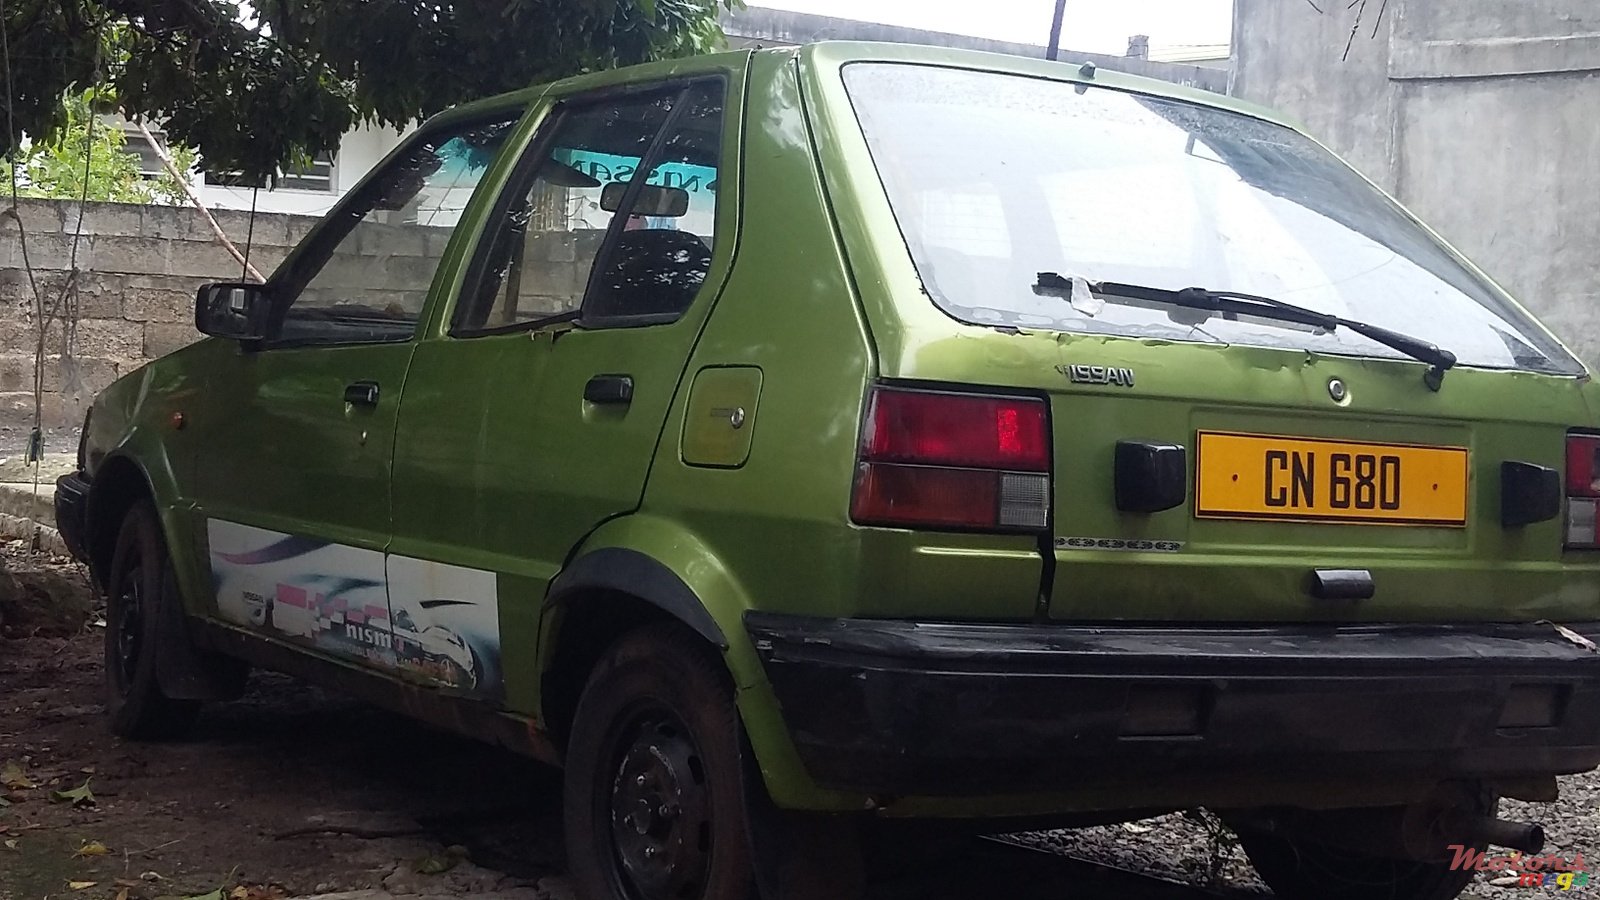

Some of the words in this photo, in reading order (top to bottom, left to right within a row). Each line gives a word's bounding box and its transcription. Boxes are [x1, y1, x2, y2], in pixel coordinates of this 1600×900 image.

[1055, 364, 1135, 387] ISSAN
[1265, 450, 1315, 507] CN
[1329, 453, 1401, 510] 680
